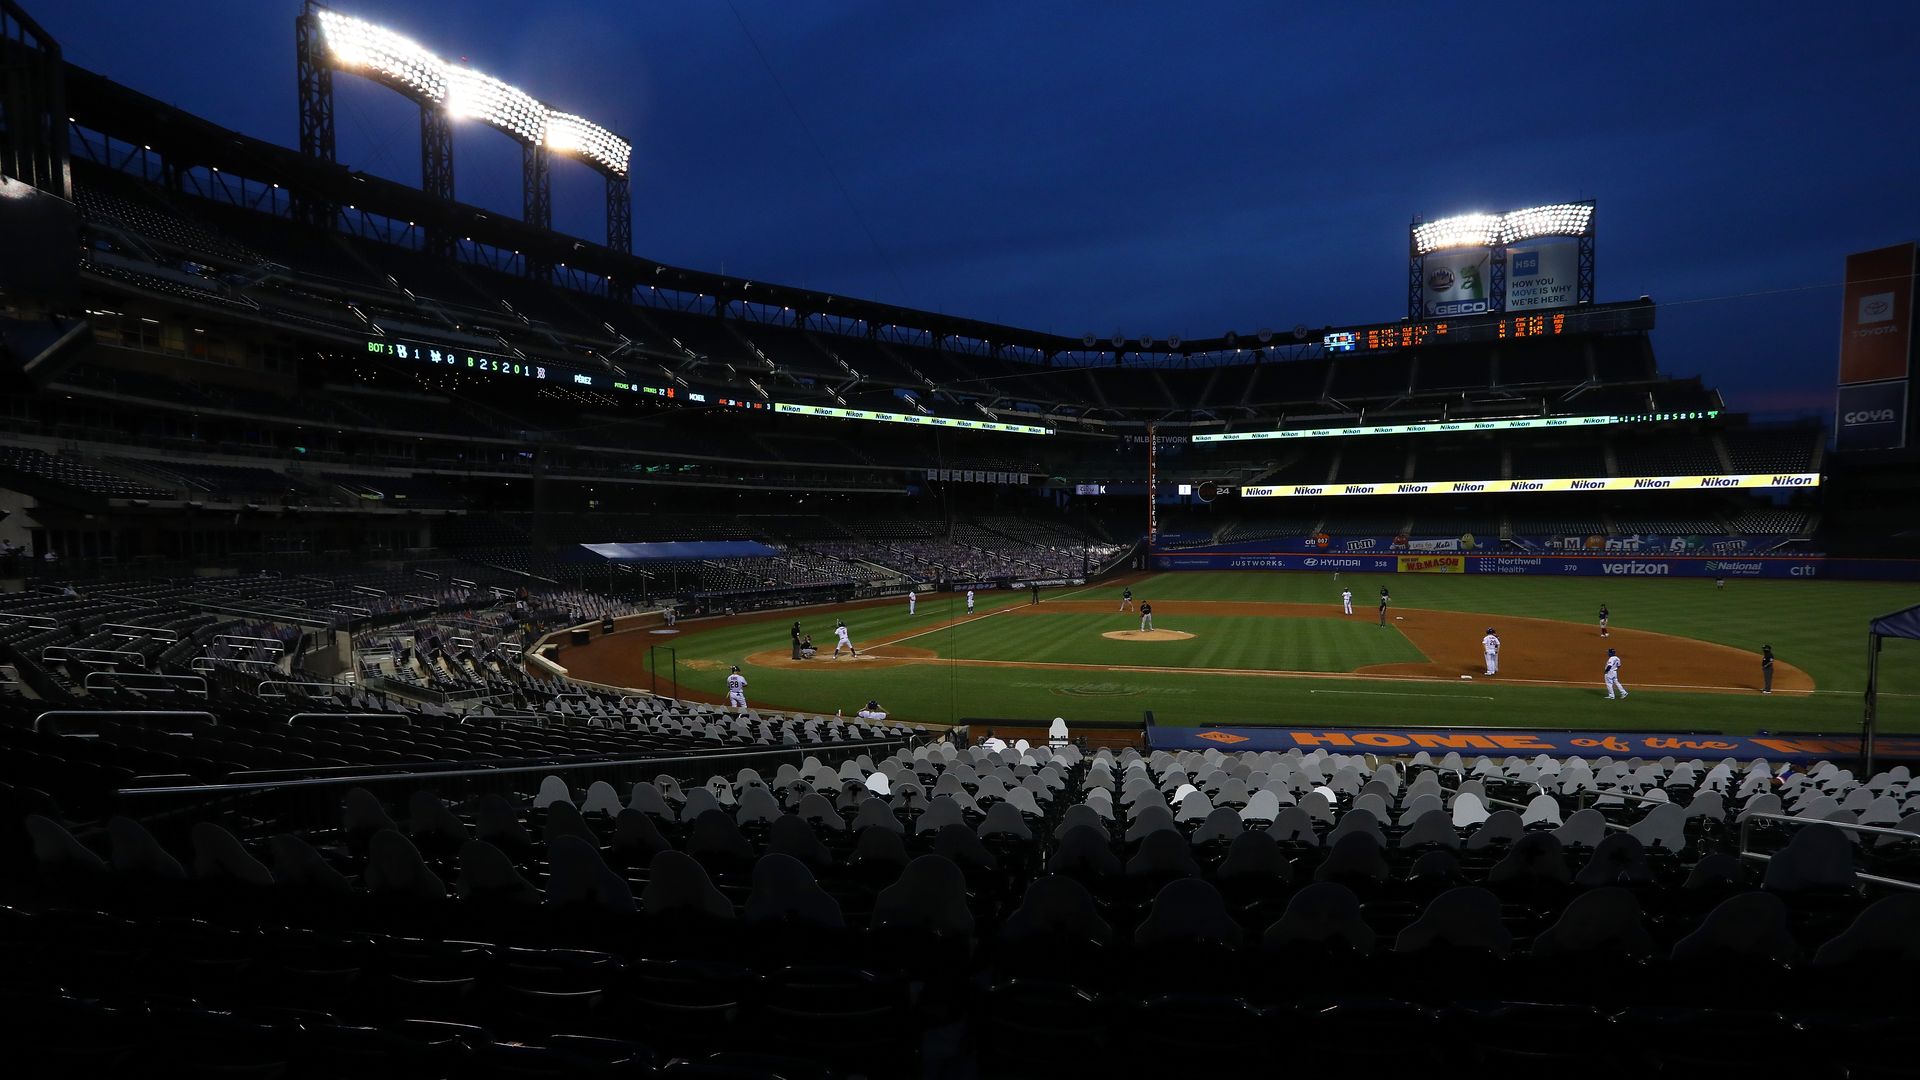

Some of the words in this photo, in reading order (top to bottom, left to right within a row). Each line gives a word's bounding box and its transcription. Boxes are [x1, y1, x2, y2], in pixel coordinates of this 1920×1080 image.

[1515, 259, 1536, 269] HSS
[1512, 279, 1534, 289] HOW
[1535, 277, 1554, 286] YOU
[1512, 288, 1537, 297] MOVE
[1539, 286, 1548, 294] IS
[1550, 284, 1572, 293] WHY
[1512, 296, 1539, 306] WE'RE
[1435, 301, 1486, 315] GEICO
[1854, 325, 1898, 337] TOYOTA
[368, 342, 384, 353] BOT
[388, 345, 393, 355] 3
[414, 349, 420, 359] 1
[447, 354, 455, 365] 0
[467, 357, 474, 367] B
[480, 359, 488, 370] 2
[492, 361, 498, 371] S
[502, 362, 510, 374] 2
[814, 407, 833, 415] Nikon
[904, 415, 920, 423] Nikon
[1844, 408, 1894, 424] GOYA
[1134, 436, 1150, 444] MLB
[1154, 435, 1188, 443] ETWORK
[1100, 485, 1106, 494] K
[1217, 487, 1230, 495] 24
[1245, 487, 1273, 496] Nikon
[1294, 486, 1323, 495] Nikon
[1345, 485, 1374, 494] Nikon
[1397, 484, 1428, 493] Nikon
[1452, 482, 1485, 492] Nikon
[1510, 481, 1544, 491] Nikon
[1570, 480, 1606, 489] Nikon
[1633, 478, 1671, 488] Nikon
[1700, 477, 1740, 487] Nikon
[1771, 476, 1812, 486] Nikon
[1320, 559, 1361, 567] HYUNDAI
[1497, 557, 1541, 566] Northwell
[1717, 561, 1762, 571] National
[1564, 564, 1577, 572] 370
[1602, 561, 1669, 575] verizon
[1790, 565, 1816, 576] citi
[1289, 732, 1557, 749] HOME
[1570, 736, 1631, 752] of
[1642, 736, 1739, 750] the
